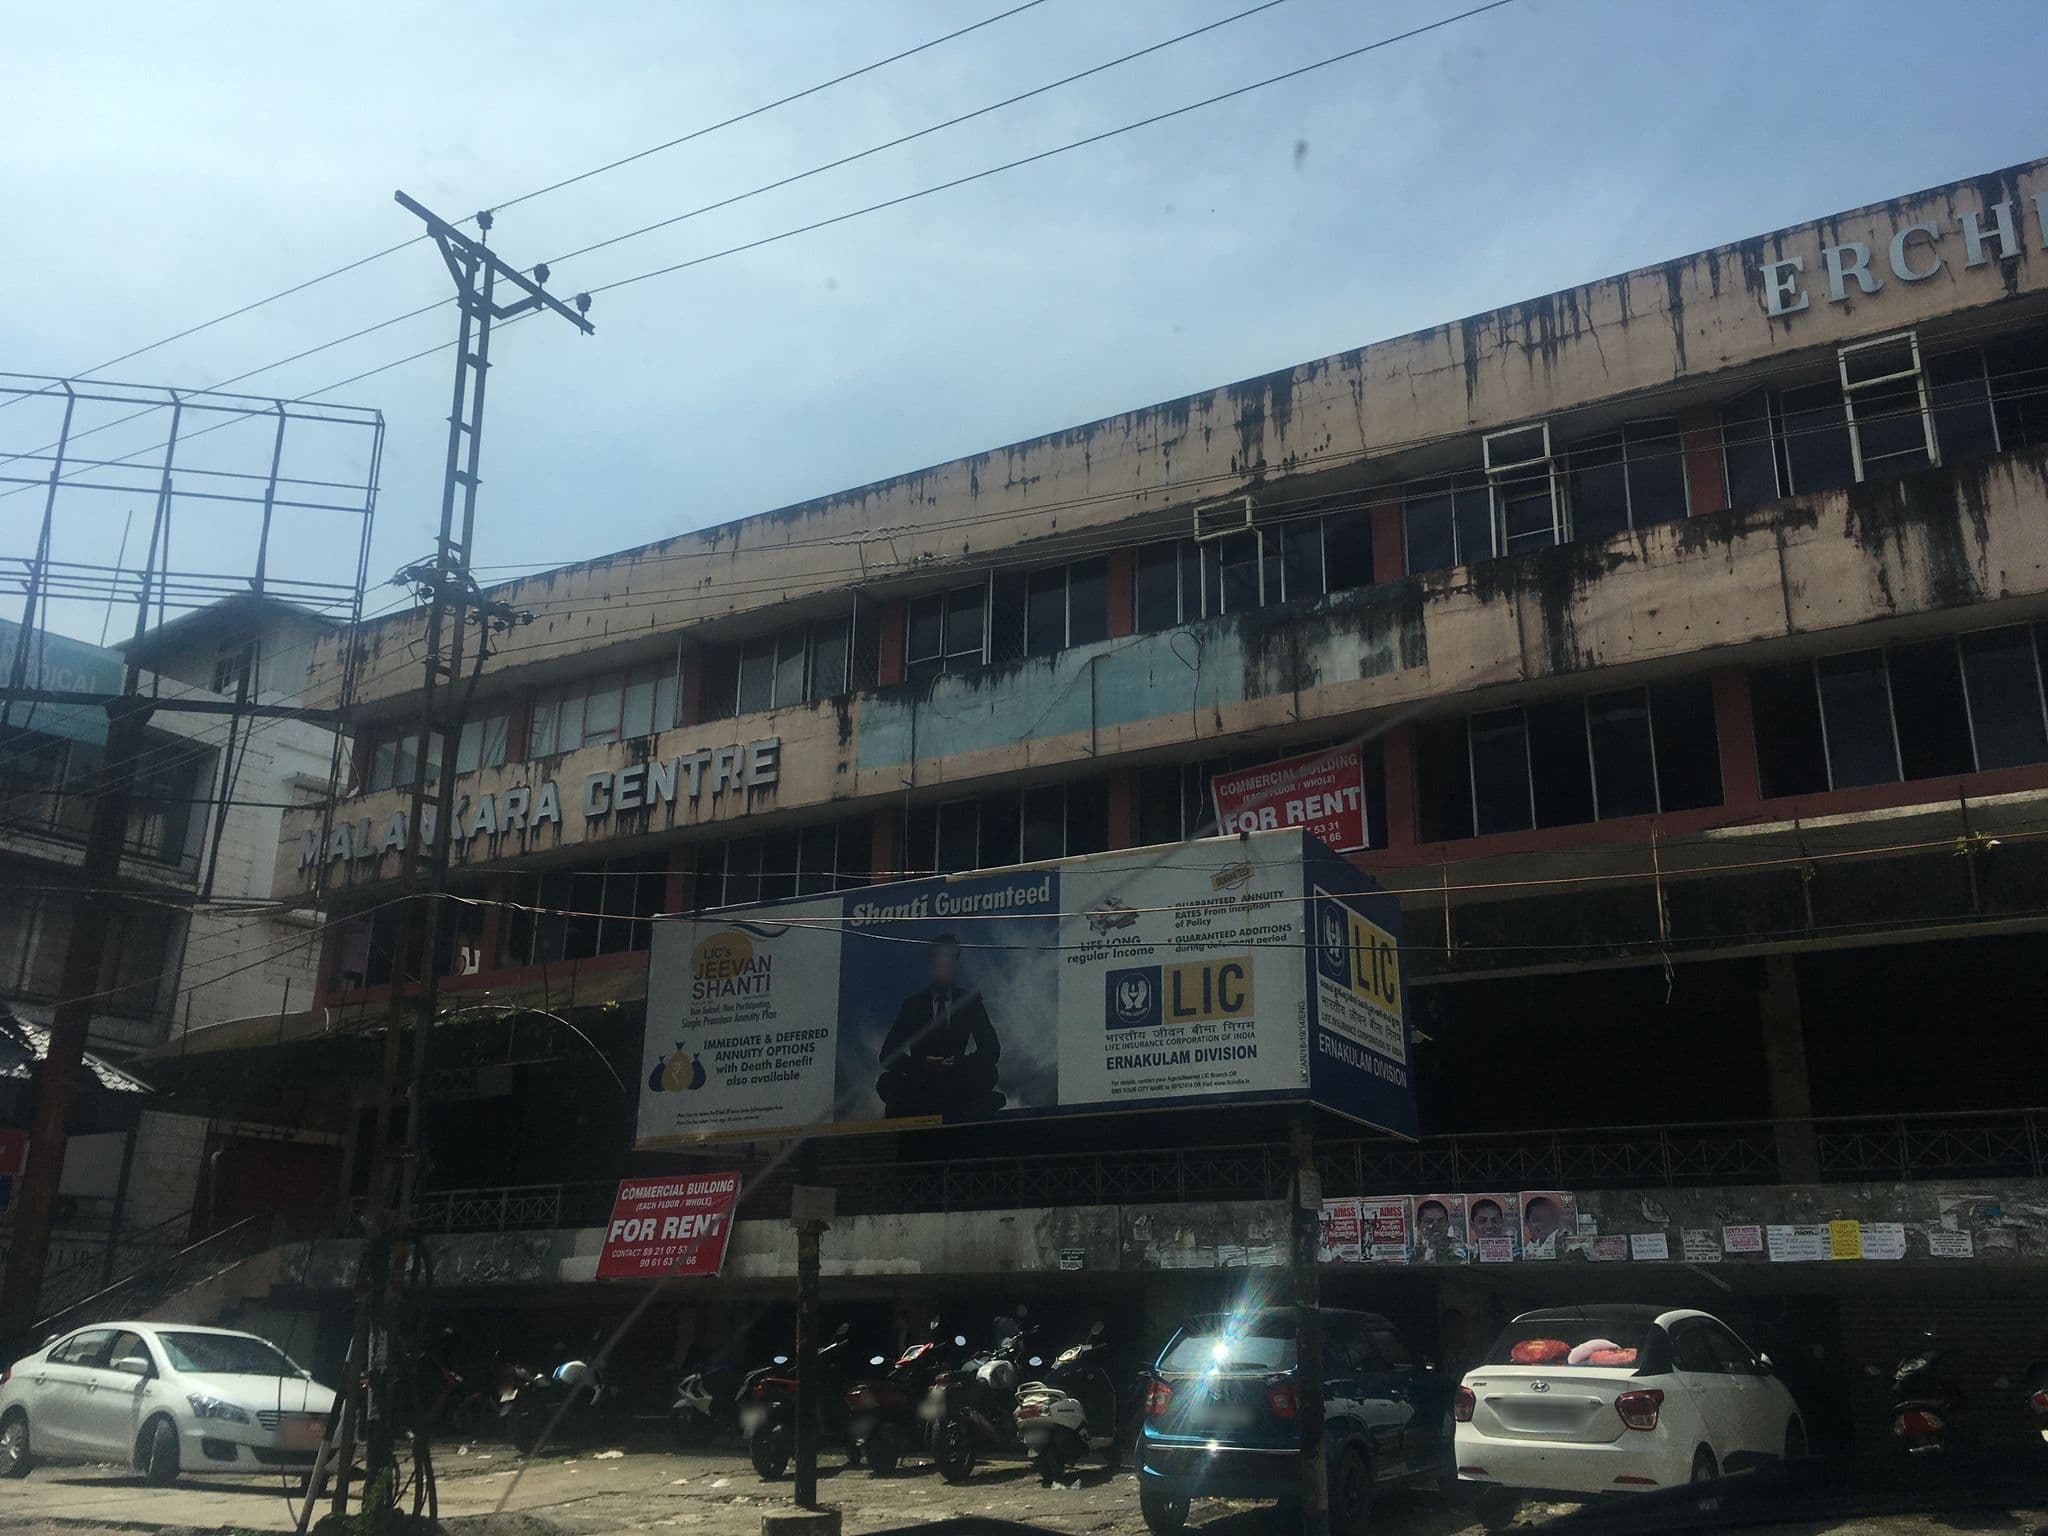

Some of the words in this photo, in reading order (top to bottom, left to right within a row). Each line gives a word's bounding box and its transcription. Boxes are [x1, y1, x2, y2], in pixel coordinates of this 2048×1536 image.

[583, 736, 781, 818] CENTRE
[1220, 768, 1298, 797] COMMERCIAL
[1300, 753, 1358, 777] BUILDING
[1225, 806, 1278, 835] FOR
[1286, 786, 1361, 825] RENT
[850, 893, 929, 927] Shanti
[935, 876, 1051, 917] Guaranteed
[1241, 890, 1285, 903] ANNUITY
[1174, 910, 1201, 921] RATES
[1204, 906, 1227, 917] From
[1229, 902, 1271, 915] Inception
[1175, 919, 1186, 929] of
[1188, 917, 1212, 930] Policy
[1175, 930, 1237, 944] GUARANTEED
[1239, 923, 1292, 938] ADDITIONS
[1256, 933, 1287, 948] period
[704, 945, 732, 960] LIC's
[1067, 951, 1109, 965] regular
[1112, 946, 1155, 959] Income
[694, 954, 772, 981] JEEVAN
[1354, 925, 1395, 1005] LIC
[692, 973, 771, 1000] SHANTI
[1172, 962, 1245, 1017] LIC
[704, 1035, 761, 1050] IMMEDIATE
[765, 1034, 773, 1044] &
[776, 1028, 829, 1042] DEFERRED
[1105, 1042, 1121, 1051] LIFE
[1122, 1039, 1165, 1050] INSURANCE
[1167, 1034, 1220, 1046] CORPORATION
[1222, 1033, 1232, 1041] OF
[1234, 1031, 1256, 1040] INDIA
[1106, 1029, 1146, 1041] भारतीय
[1152, 1027, 1185, 1039] जीवन
[1191, 1023, 1217, 1036] बीमा
[1223, 1020, 1255, 1033] निगम
[715, 1048, 763, 1062] ANNUITY
[767, 1042, 816, 1058] OPTIONS
[1106, 1050, 1191, 1070] ERNAKULAM
[1195, 1044, 1258, 1062] DIVISION
[1319, 1033, 1372, 1072] ERNAKULAM
[1373, 1053, 1408, 1088] DIVISION
[716, 1061, 738, 1074] with
[741, 1059, 773, 1072] Death
[775, 1056, 813, 1068] Benefit
[726, 1075, 748, 1087] also
[750, 1070, 801, 1085] available
[621, 1184, 684, 1200] COMMERCIAL
[687, 1179, 735, 1195] BUILDING
[635, 1200, 656, 1211] (EACH
[658, 1198, 680, 1209] FLOOR
[685, 1197, 712, 1207] WHOLE)
[608, 1218, 657, 1243] FOR
[660, 1213, 726, 1240] RENT
